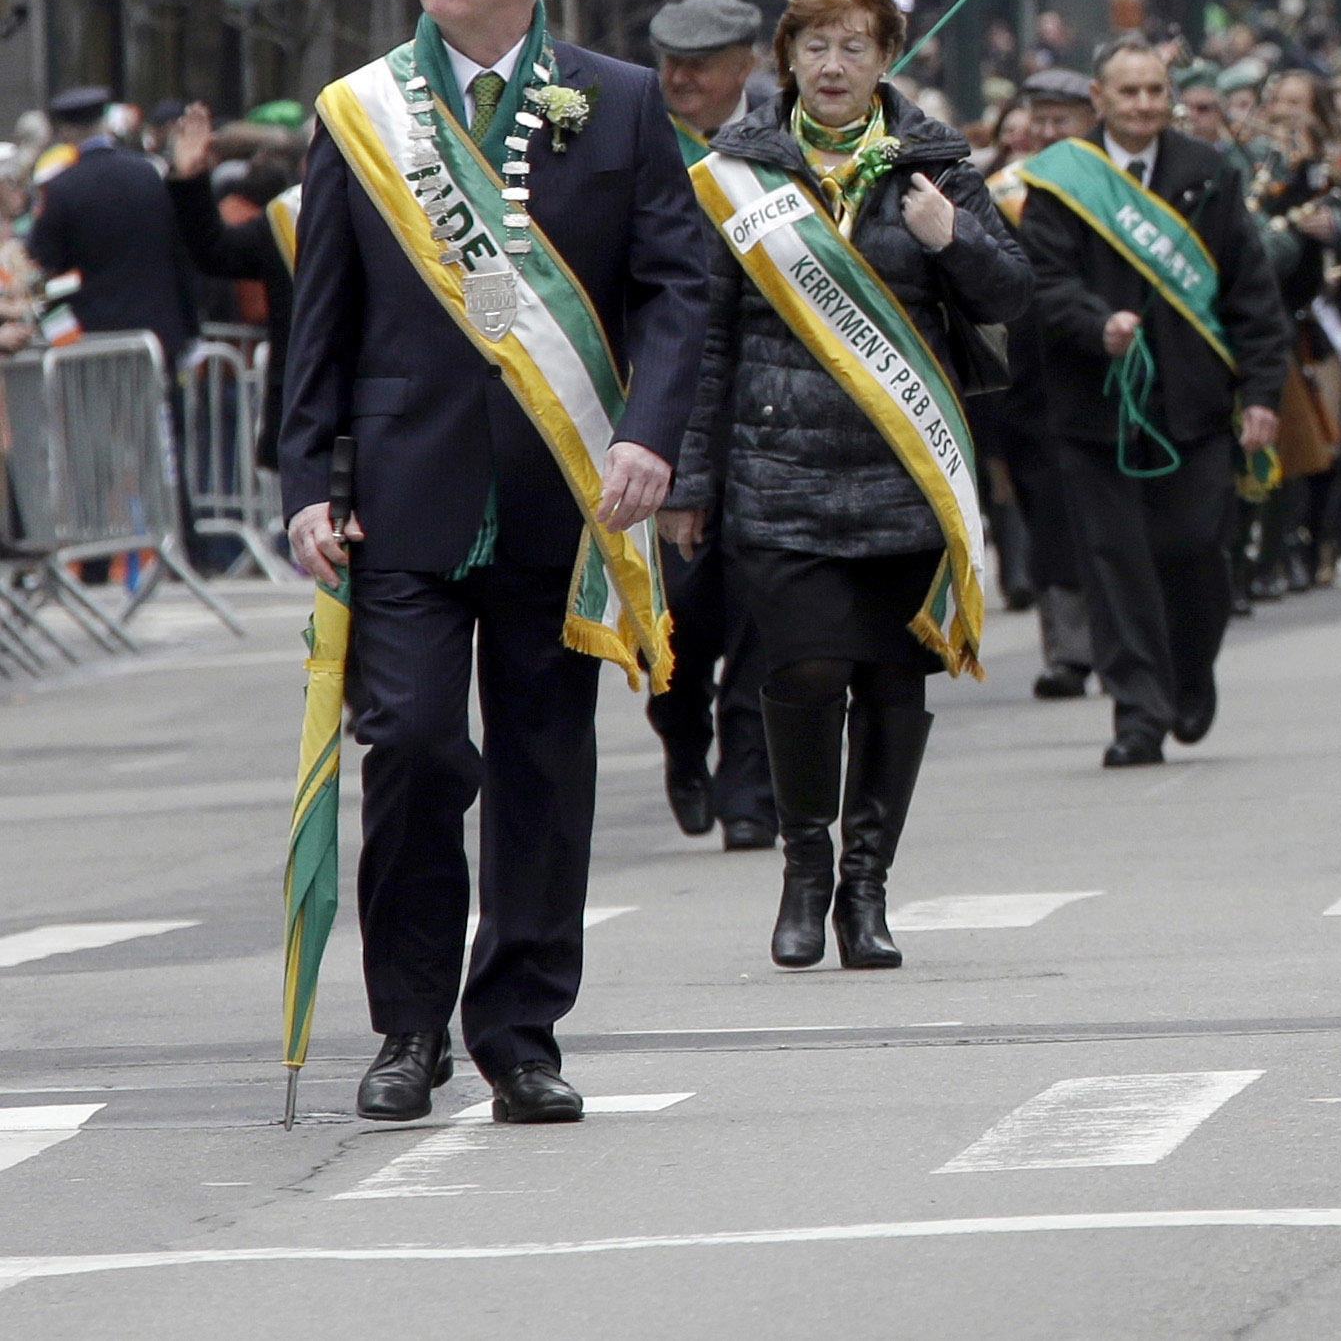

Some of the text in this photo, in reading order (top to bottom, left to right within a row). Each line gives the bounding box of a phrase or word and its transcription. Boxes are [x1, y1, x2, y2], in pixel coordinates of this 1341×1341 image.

[733, 193, 800, 243] OFFICER
[789, 254, 898, 374] KERRYMEN'S
[924, 418, 963, 477] ASS'N
